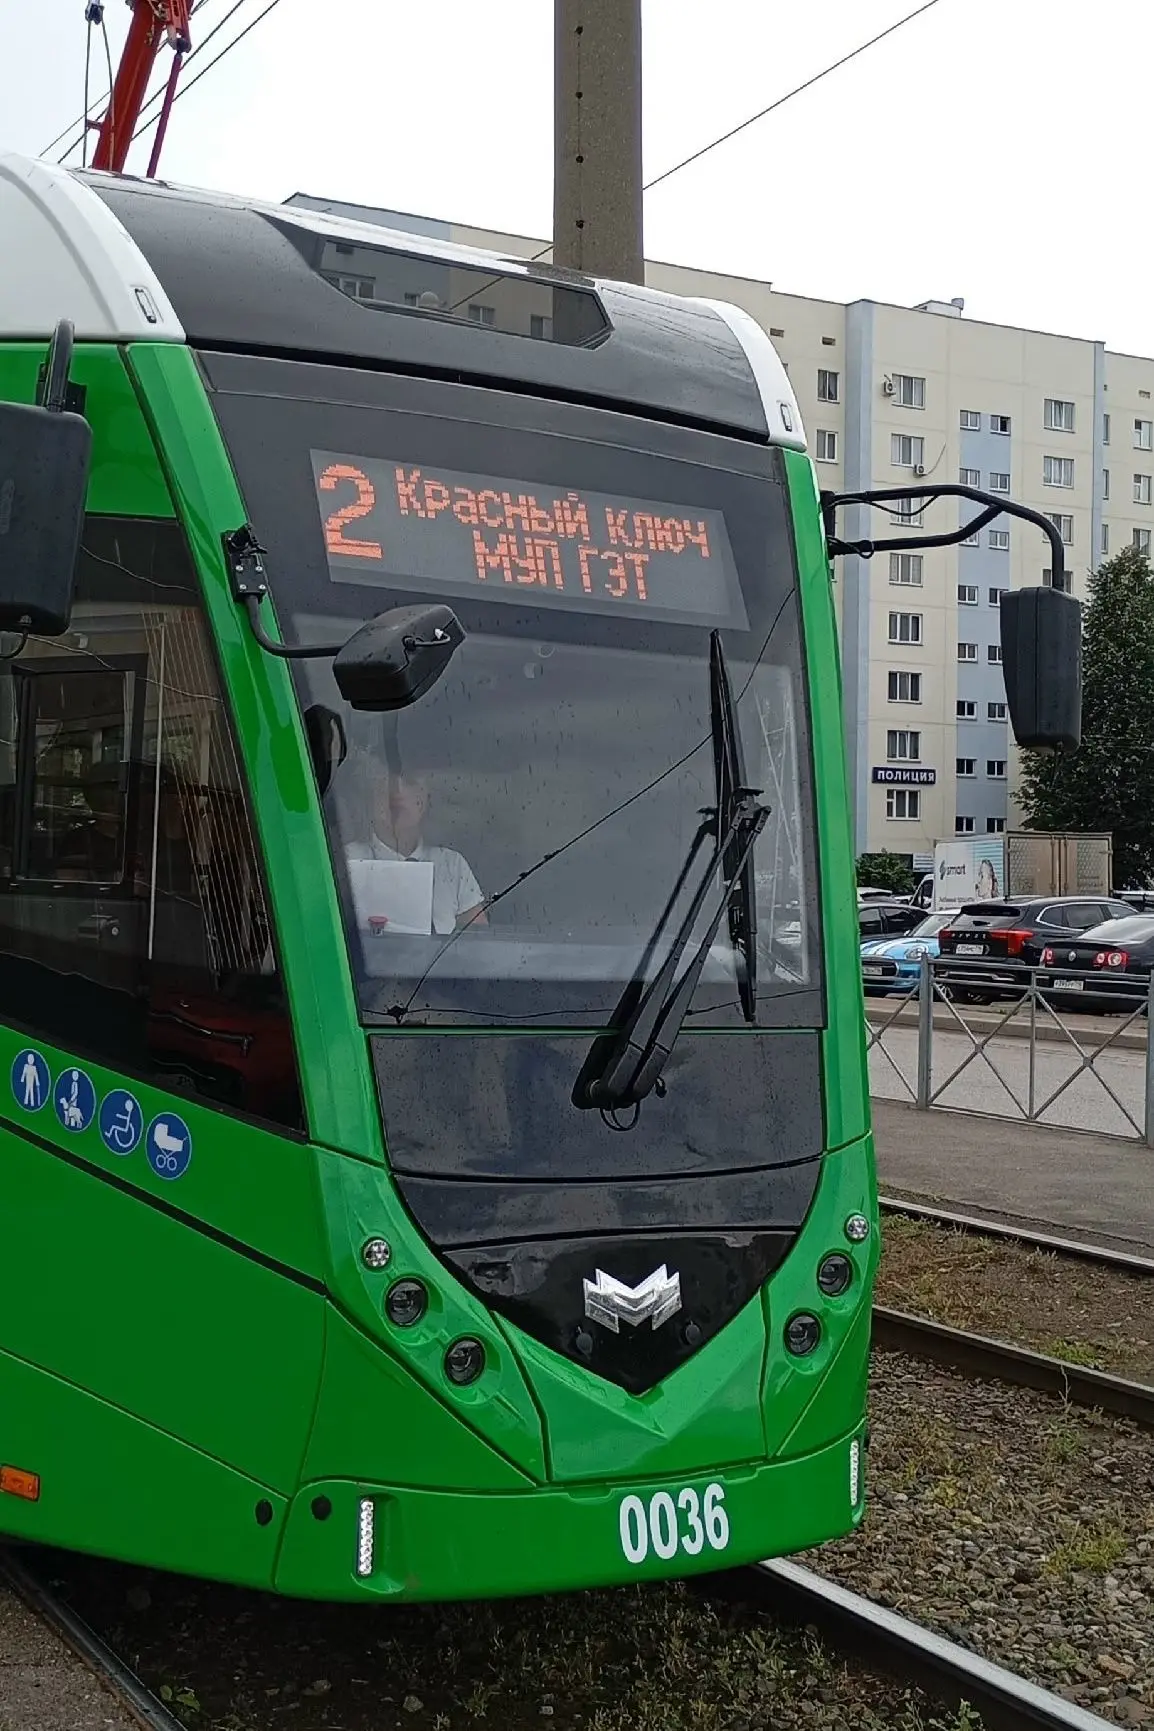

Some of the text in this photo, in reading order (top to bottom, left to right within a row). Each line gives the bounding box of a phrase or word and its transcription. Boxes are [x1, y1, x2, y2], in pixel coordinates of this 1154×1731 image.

[319, 463, 383, 559] 2
[395, 467, 591, 542] Красный
[472, 529, 650, 600] МУП ГЭТ
[877, 769, 935, 782] ПОЛИЦИЯ
[619, 1482, 729, 1564] 0036
